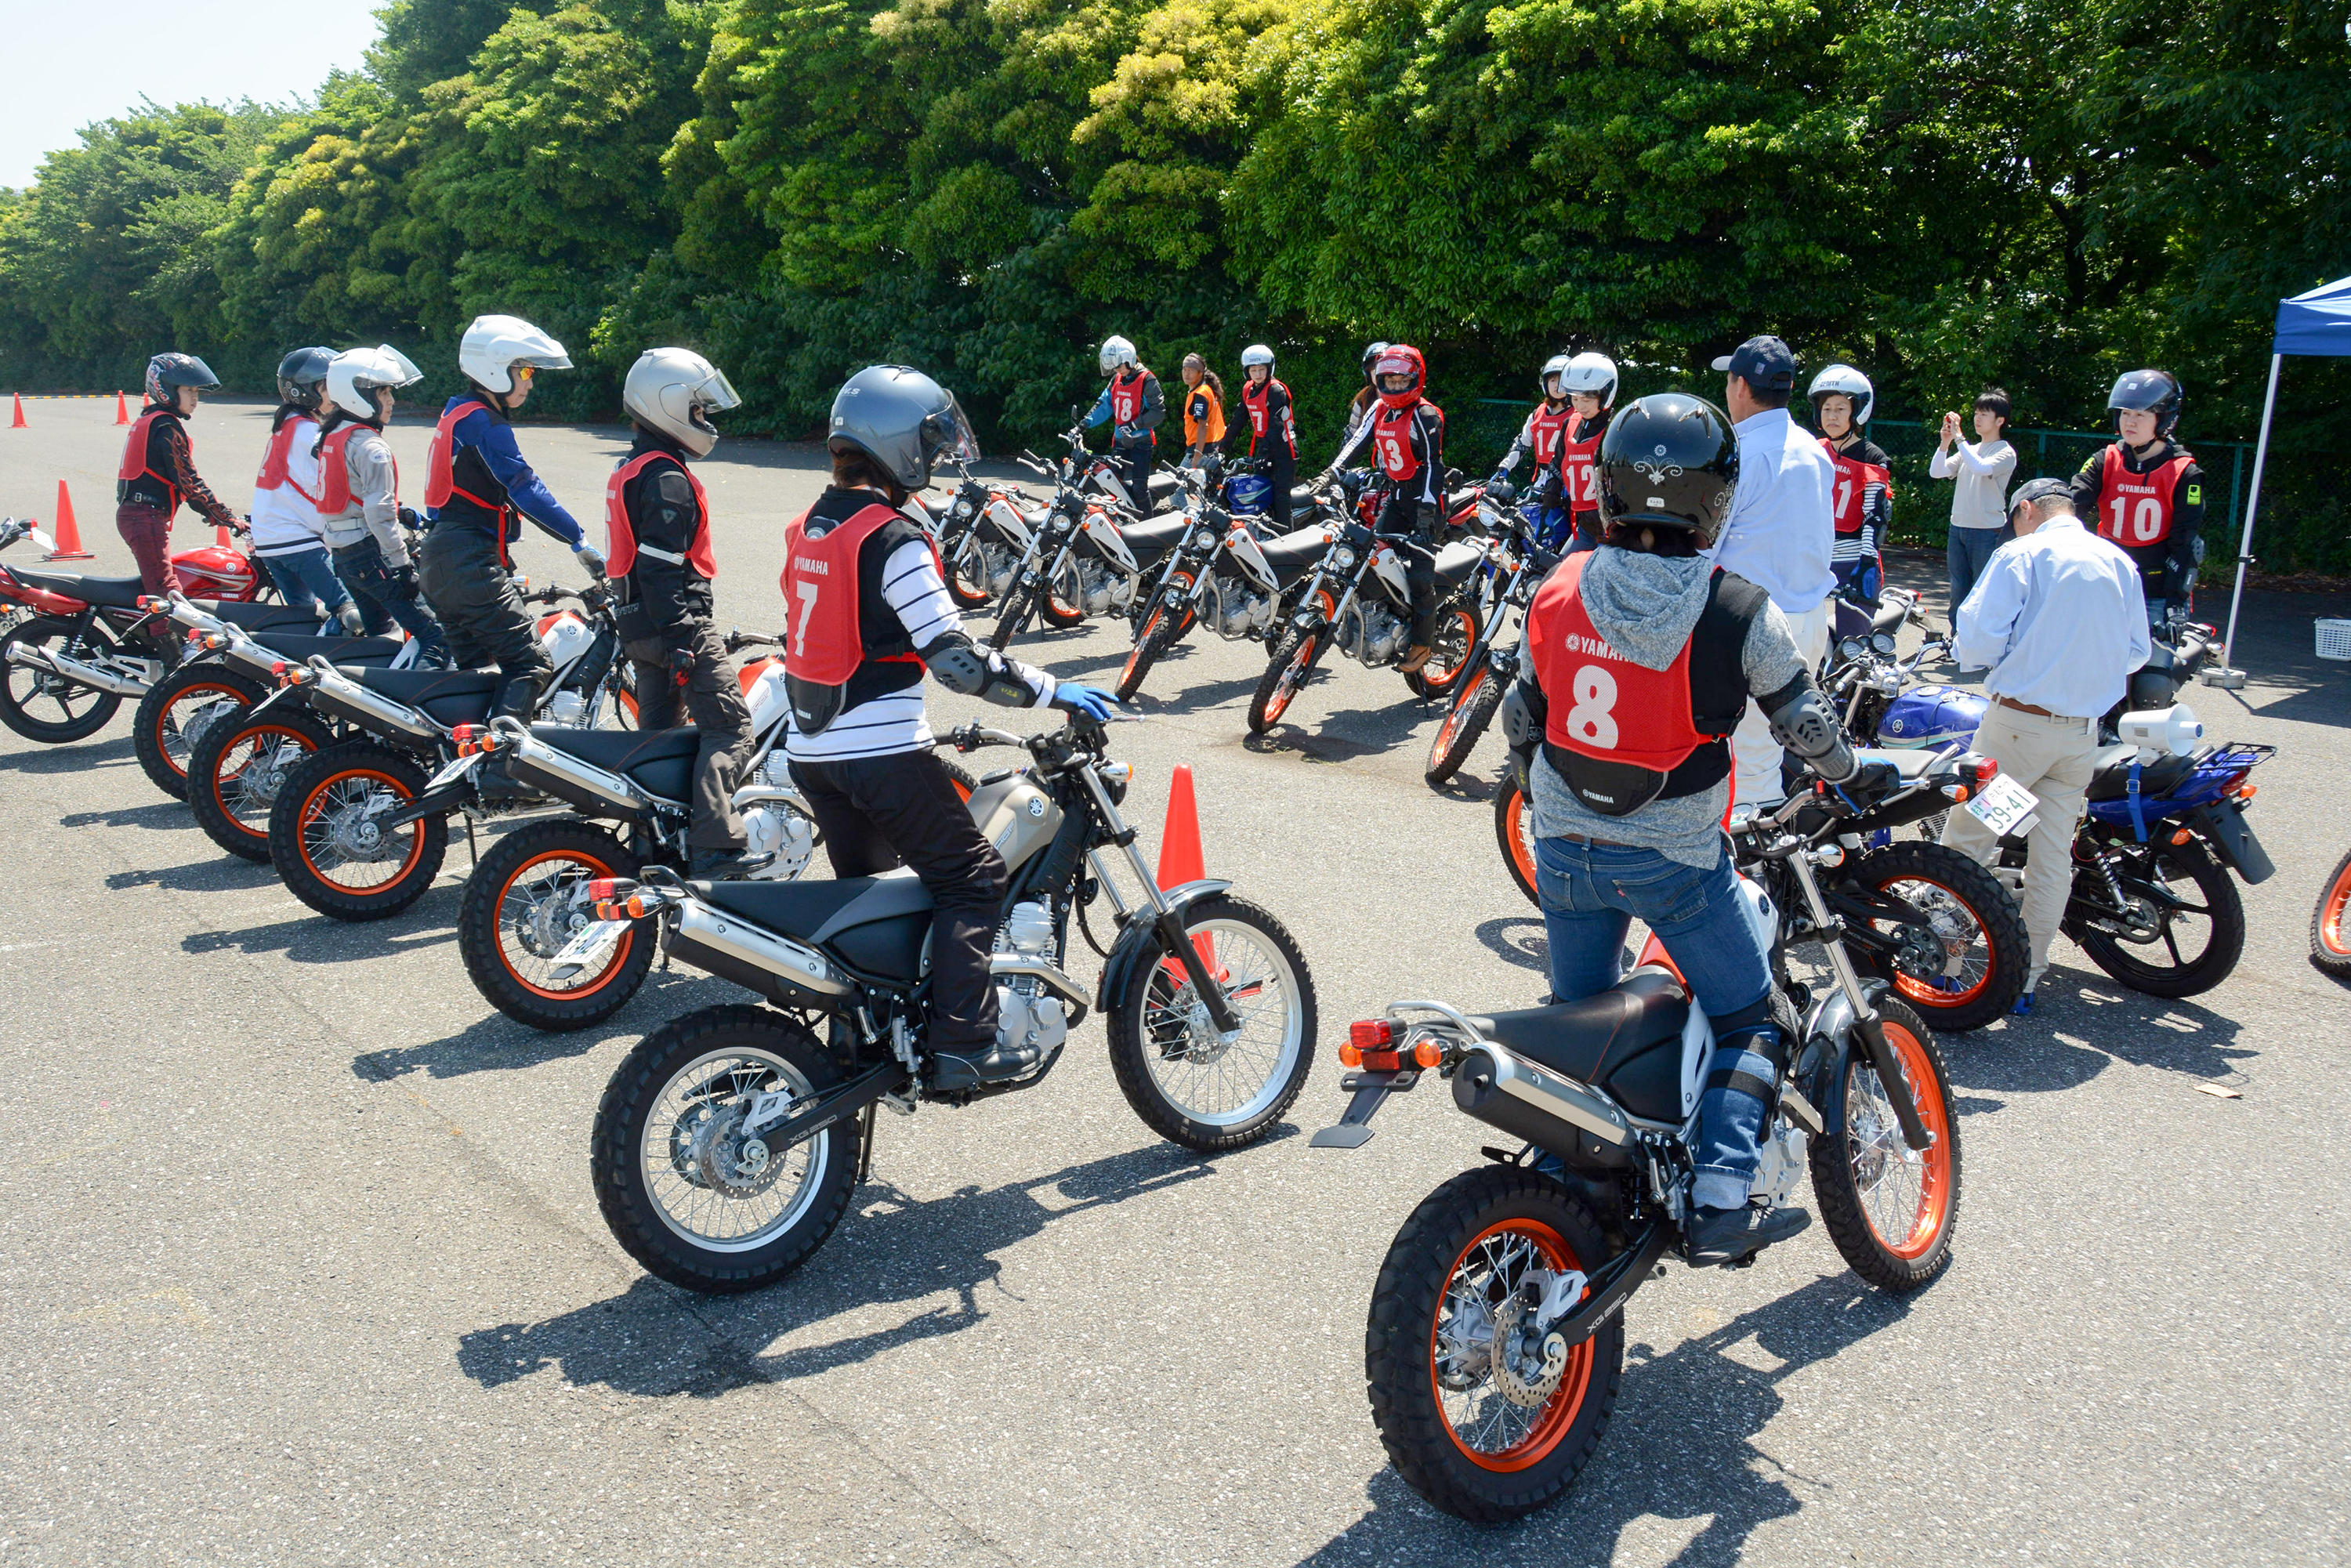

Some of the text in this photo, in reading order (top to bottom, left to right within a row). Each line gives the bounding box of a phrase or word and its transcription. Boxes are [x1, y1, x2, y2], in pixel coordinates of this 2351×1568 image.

[1114, 397, 1132, 422] 18
[1567, 464, 1598, 502] 12
[2125, 484, 2156, 494] YAMAHA
[2110, 496, 2162, 541] 10
[799, 556, 828, 576] YAMAHA
[795, 579, 818, 657] 7
[1566, 664, 1619, 750] 8
[1588, 791, 1614, 805] YAMAHA
[788, 1114, 838, 1144] XG 250
[1587, 1291, 1627, 1334] XG 250
